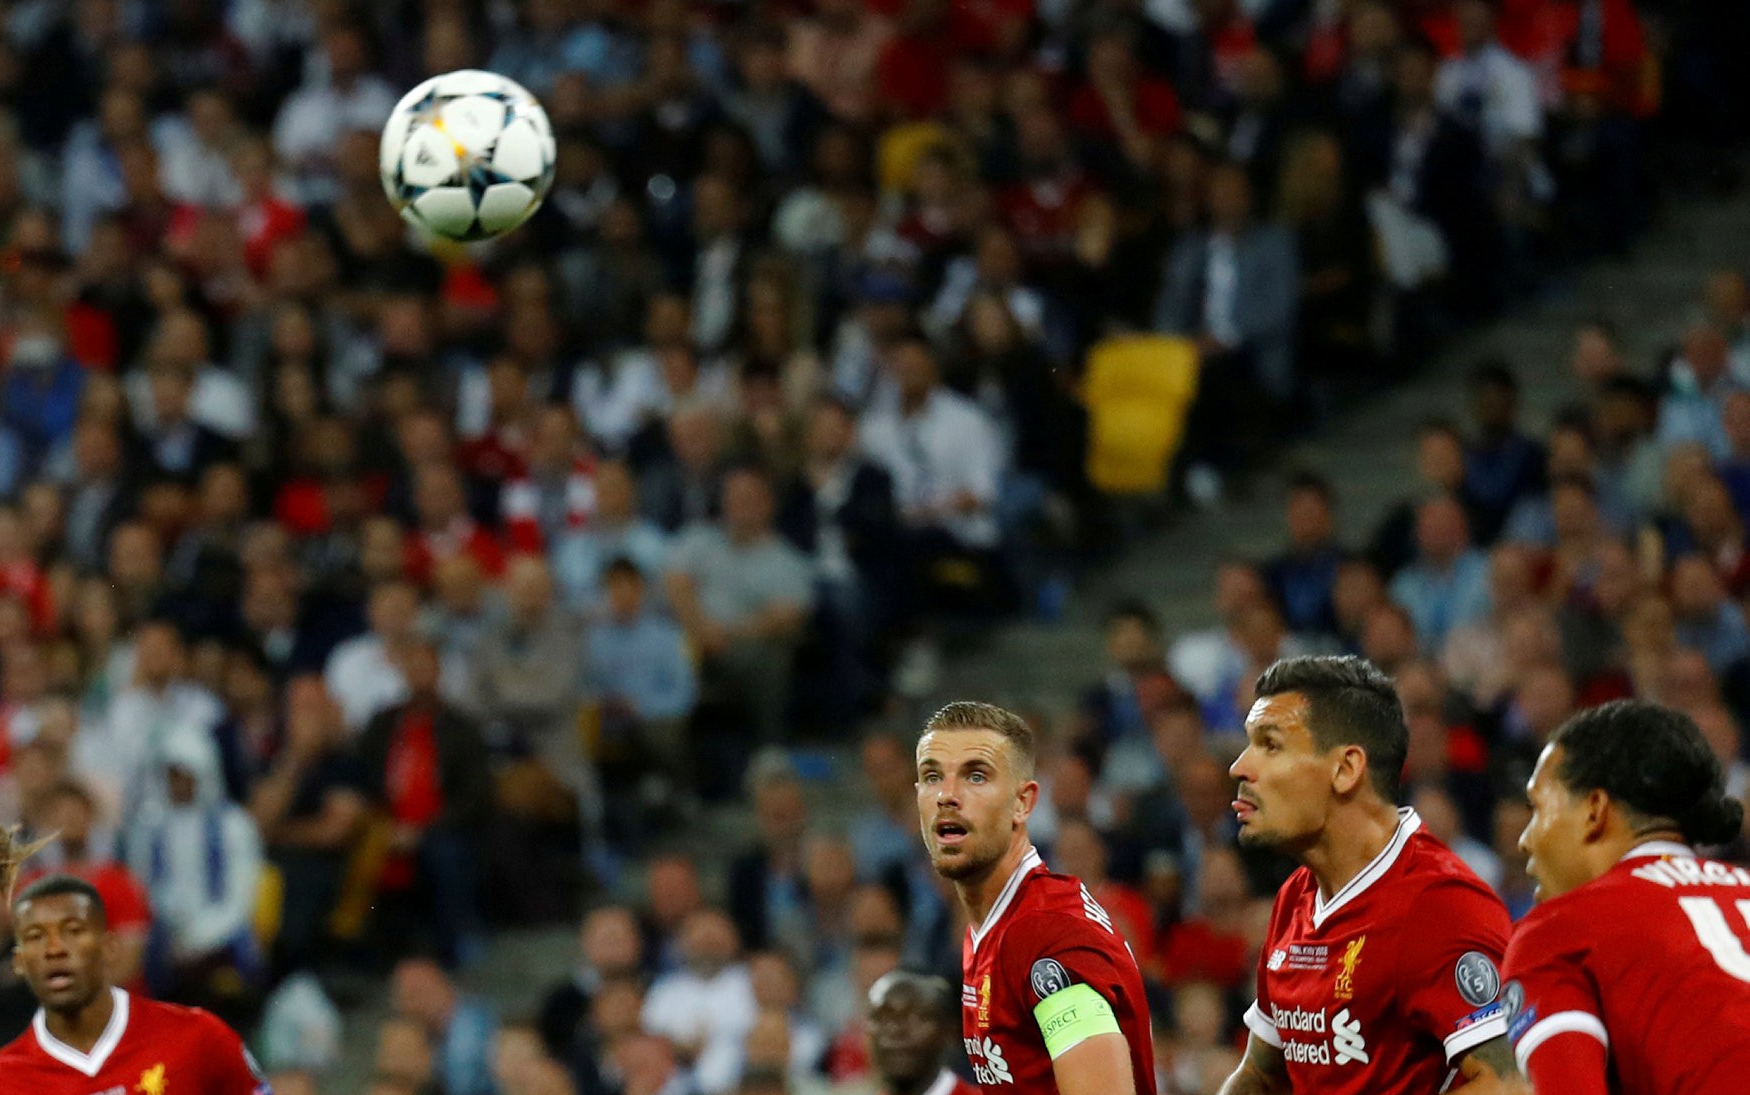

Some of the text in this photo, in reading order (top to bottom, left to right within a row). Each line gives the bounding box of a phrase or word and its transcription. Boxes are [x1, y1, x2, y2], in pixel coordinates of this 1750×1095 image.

[1631, 857, 1750, 888] VIRGI
[1047, 979, 1059, 993] 5
[1473, 977, 1485, 993] 5
